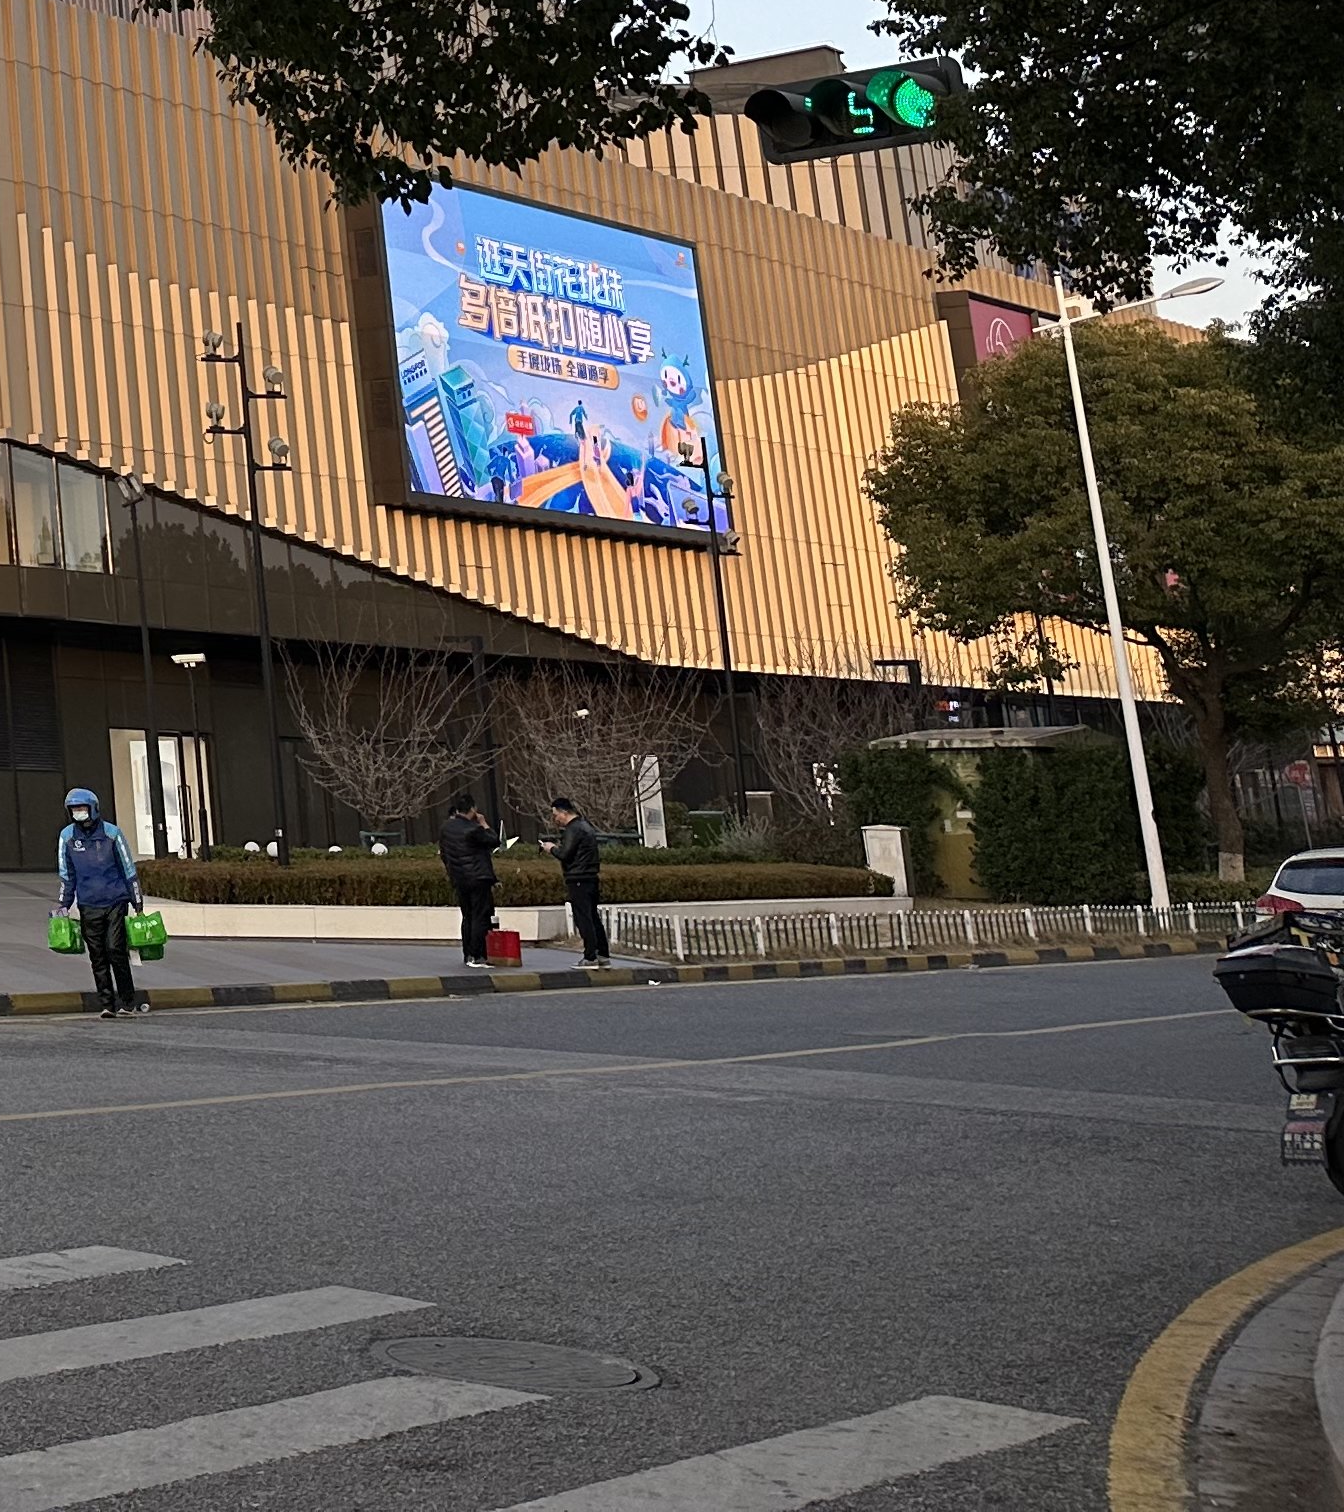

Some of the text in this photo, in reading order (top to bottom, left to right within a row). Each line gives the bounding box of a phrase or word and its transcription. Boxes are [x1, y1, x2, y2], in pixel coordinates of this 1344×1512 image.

[847, 91, 874, 134] 5
[476, 236, 626, 312] 逛天街花珑珠
[458, 273, 654, 363] 多倍抵扣随心享
